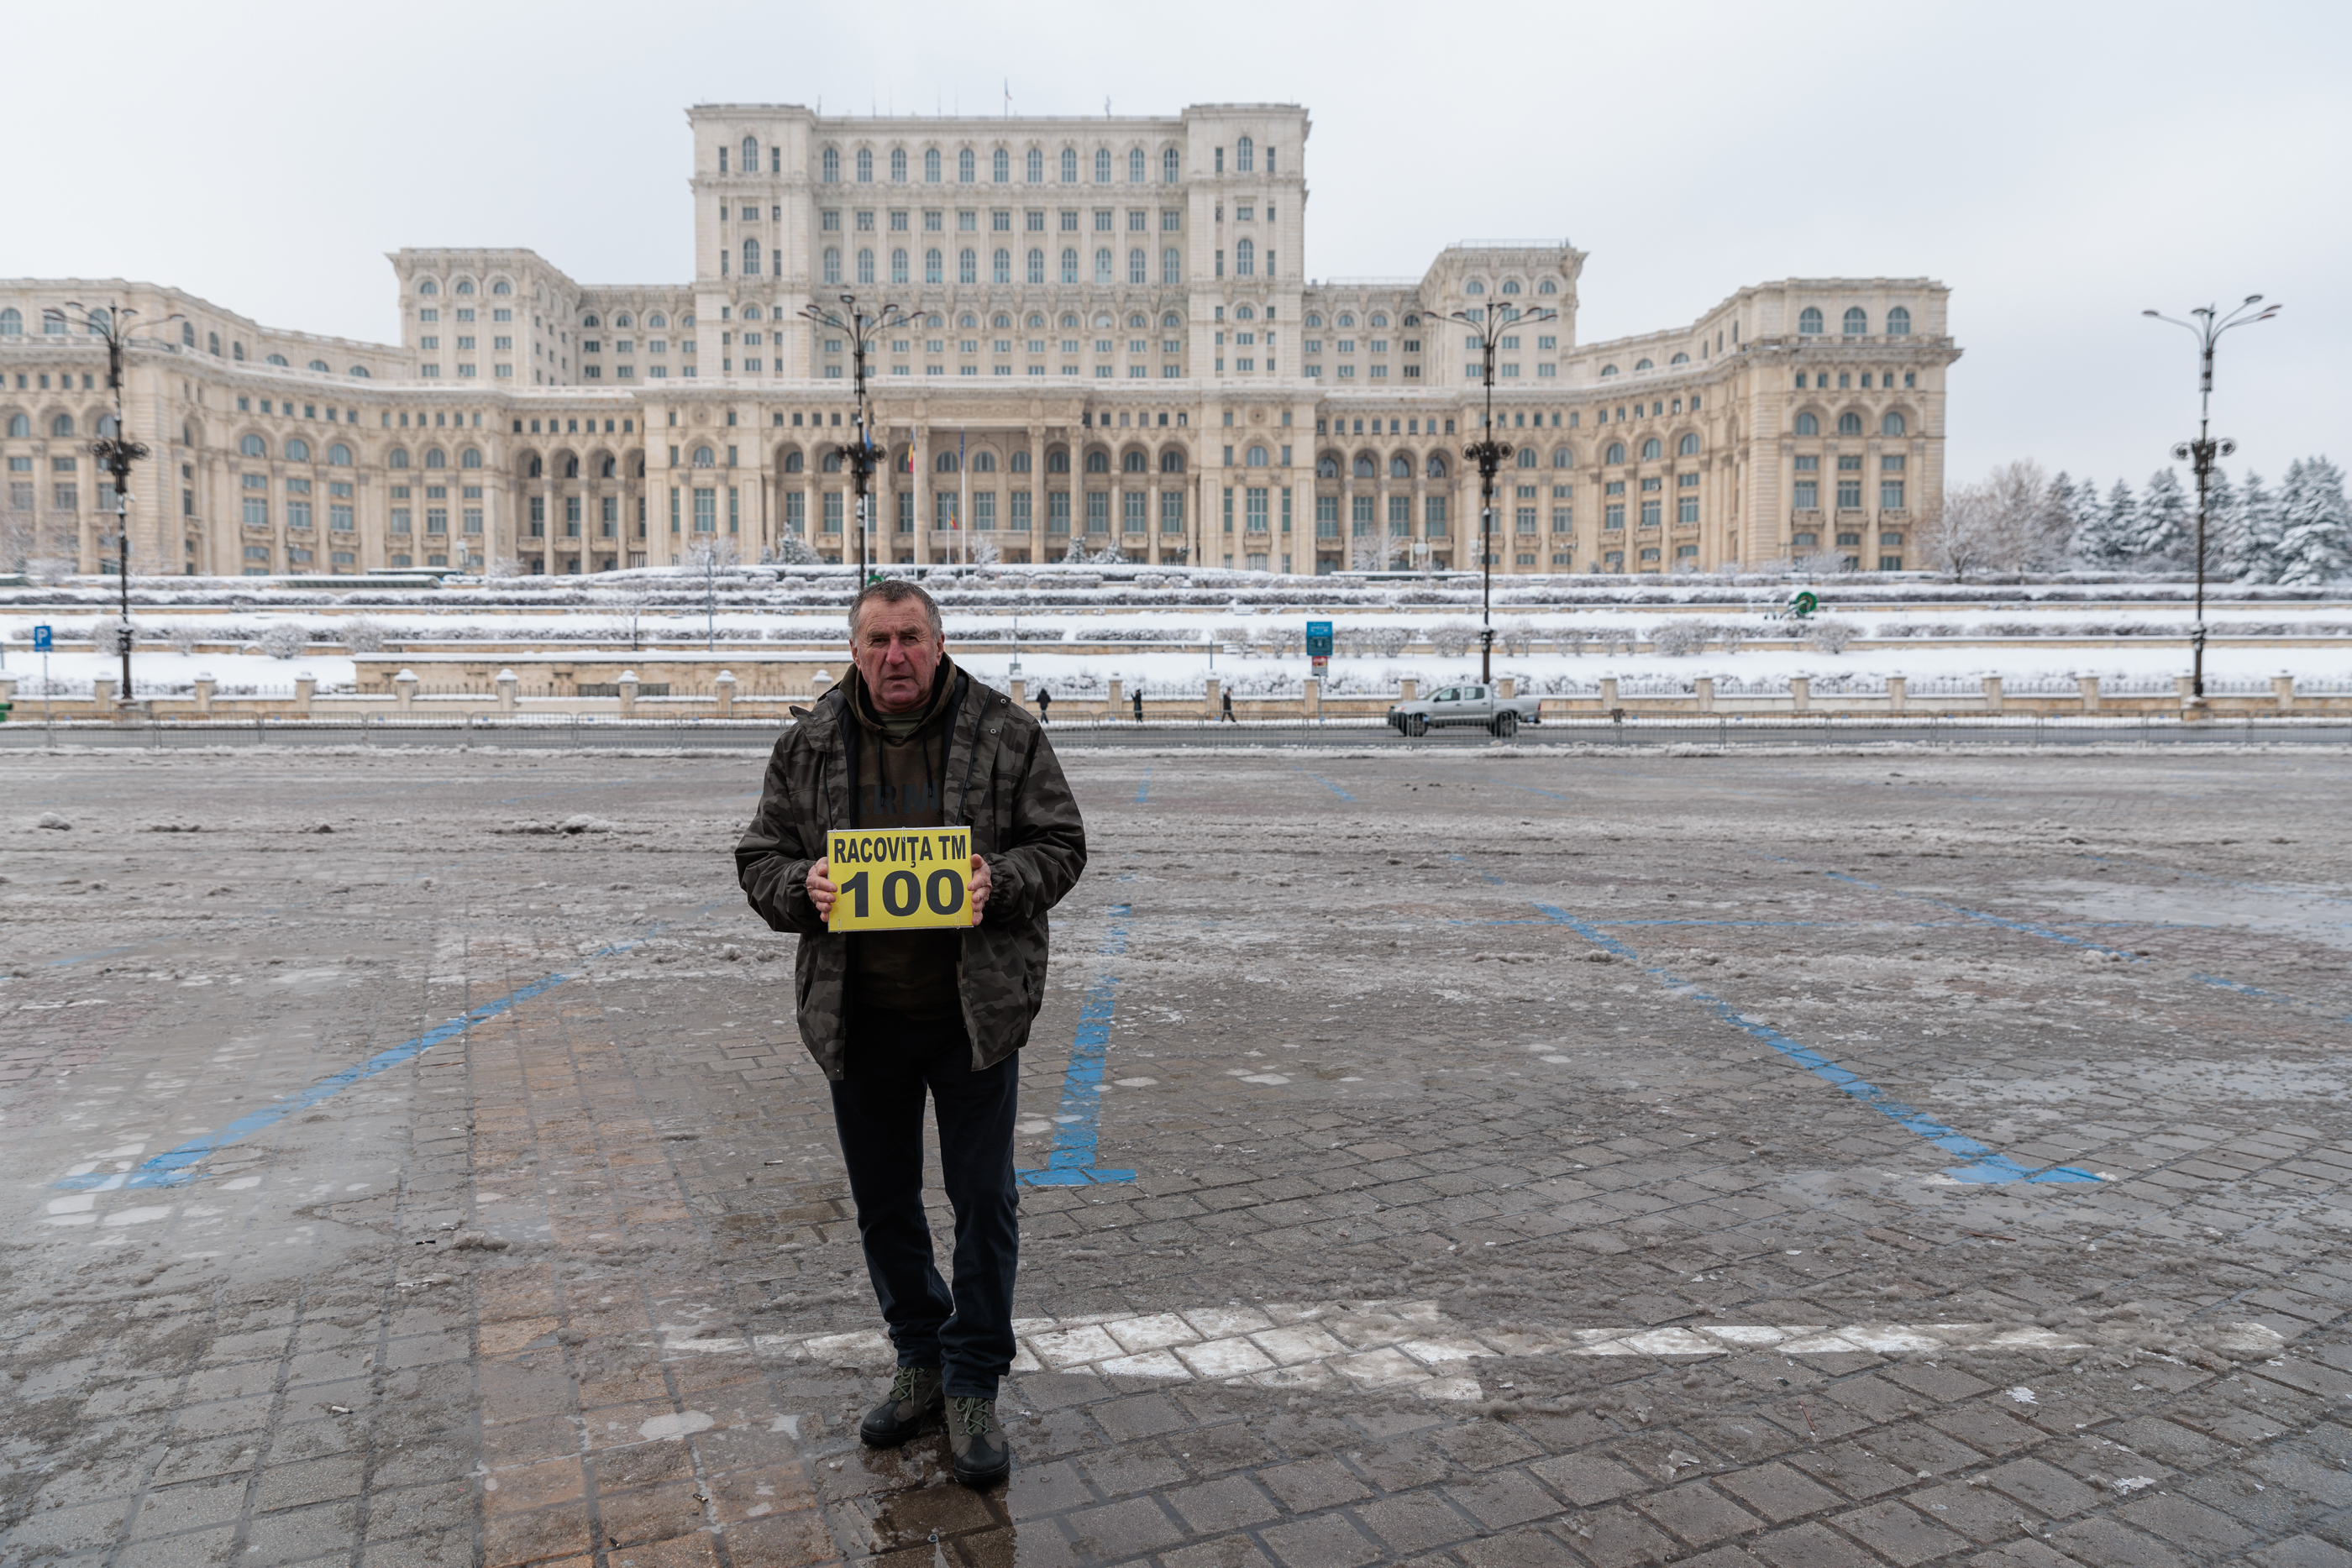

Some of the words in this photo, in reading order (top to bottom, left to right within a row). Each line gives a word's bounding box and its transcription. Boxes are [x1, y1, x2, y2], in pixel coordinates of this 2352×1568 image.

[37, 628, 48, 644] P
[938, 835, 966, 860] TM
[841, 868, 964, 918] 100
